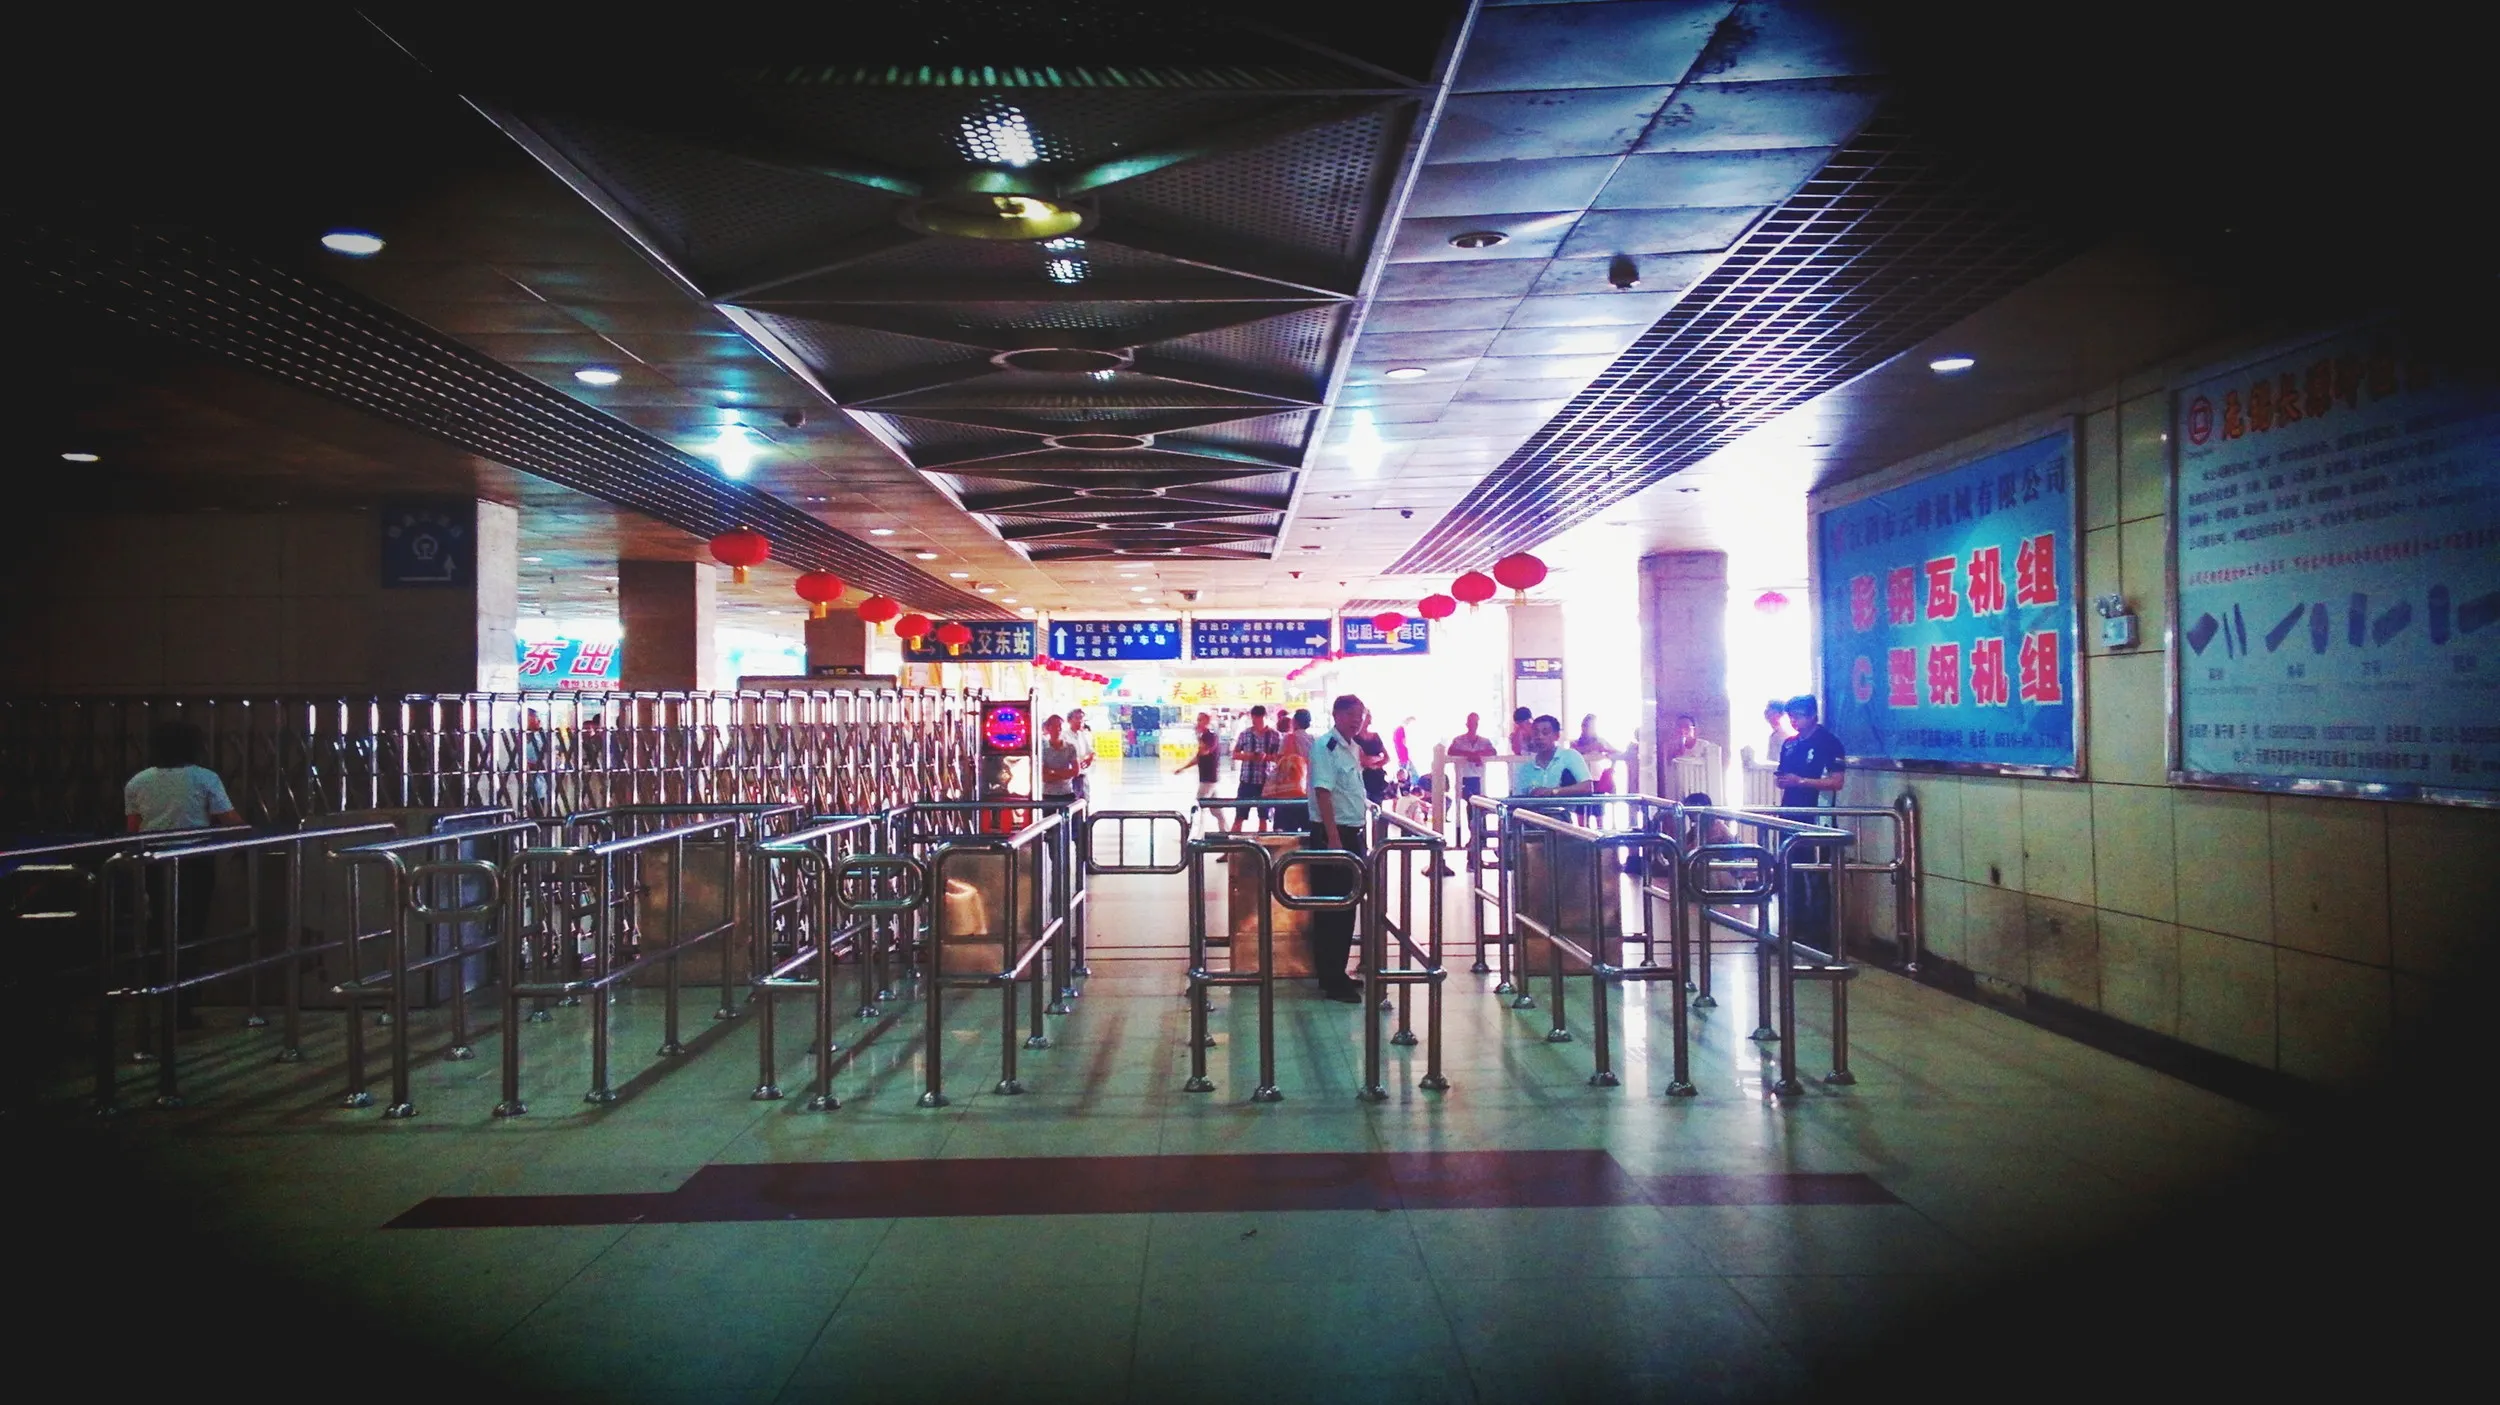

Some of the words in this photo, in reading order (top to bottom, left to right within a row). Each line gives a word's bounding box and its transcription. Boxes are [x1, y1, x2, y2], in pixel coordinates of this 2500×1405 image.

[1850, 532, 2059, 633] 彩钢瓦机组
[1075, 623, 1175, 633] D区社会停车场
[1347, 623, 1426, 640] 出租车客区
[1852, 630, 2062, 708] C型钢机组
